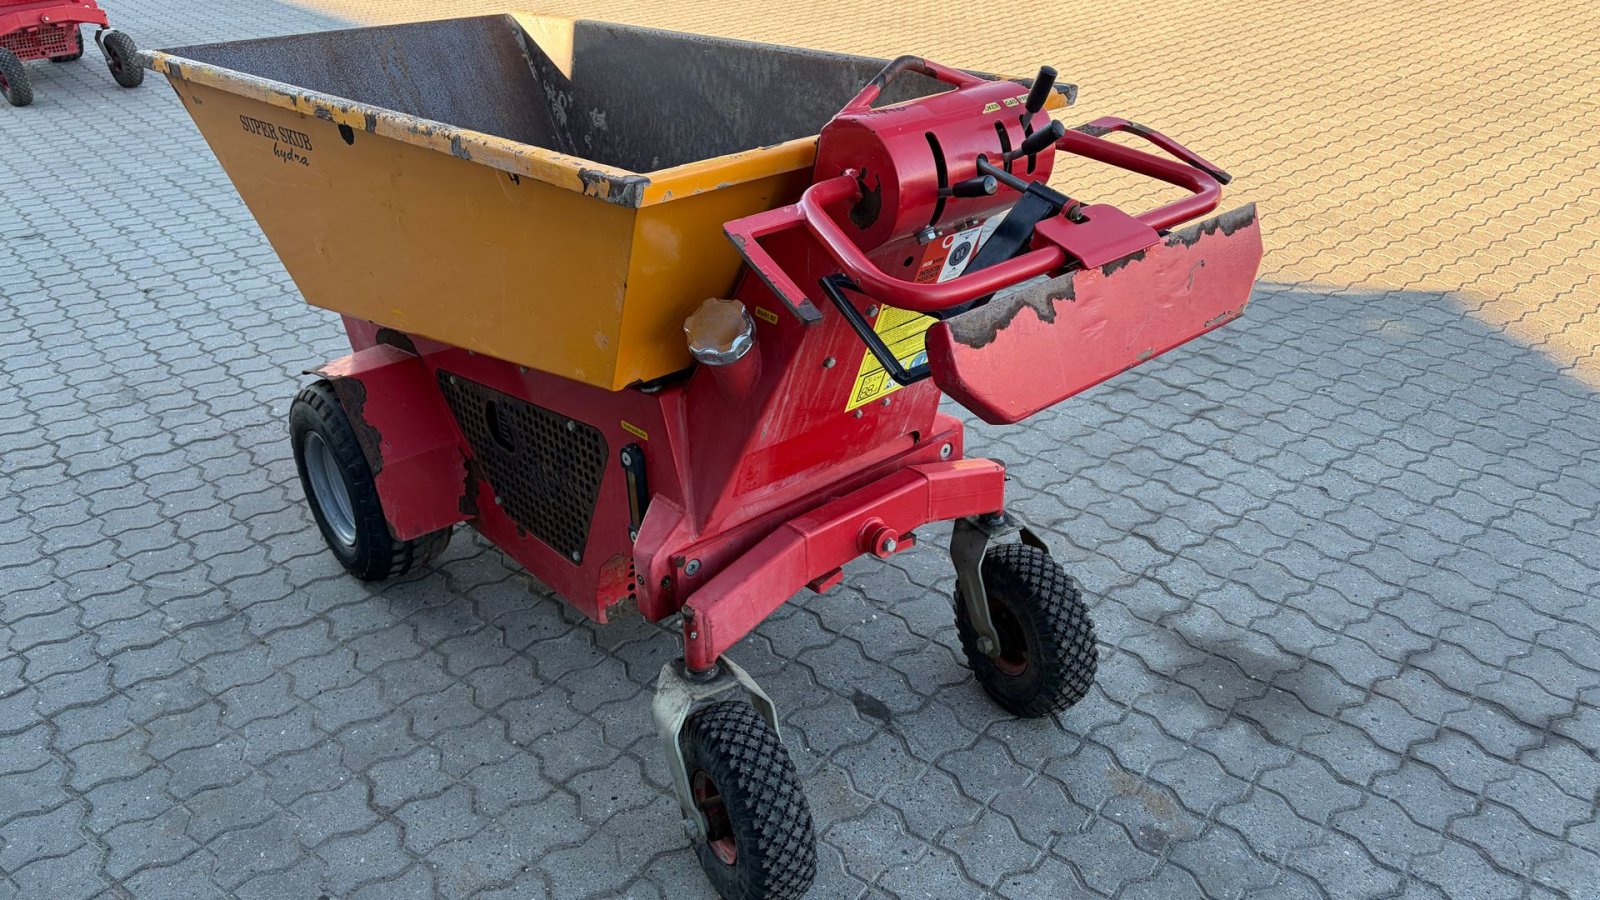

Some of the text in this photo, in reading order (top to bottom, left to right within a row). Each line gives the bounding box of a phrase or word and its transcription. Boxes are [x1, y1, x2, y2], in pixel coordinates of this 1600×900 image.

[240, 115, 312, 151] SUPER SKUB
[274, 142, 309, 166] hydra
